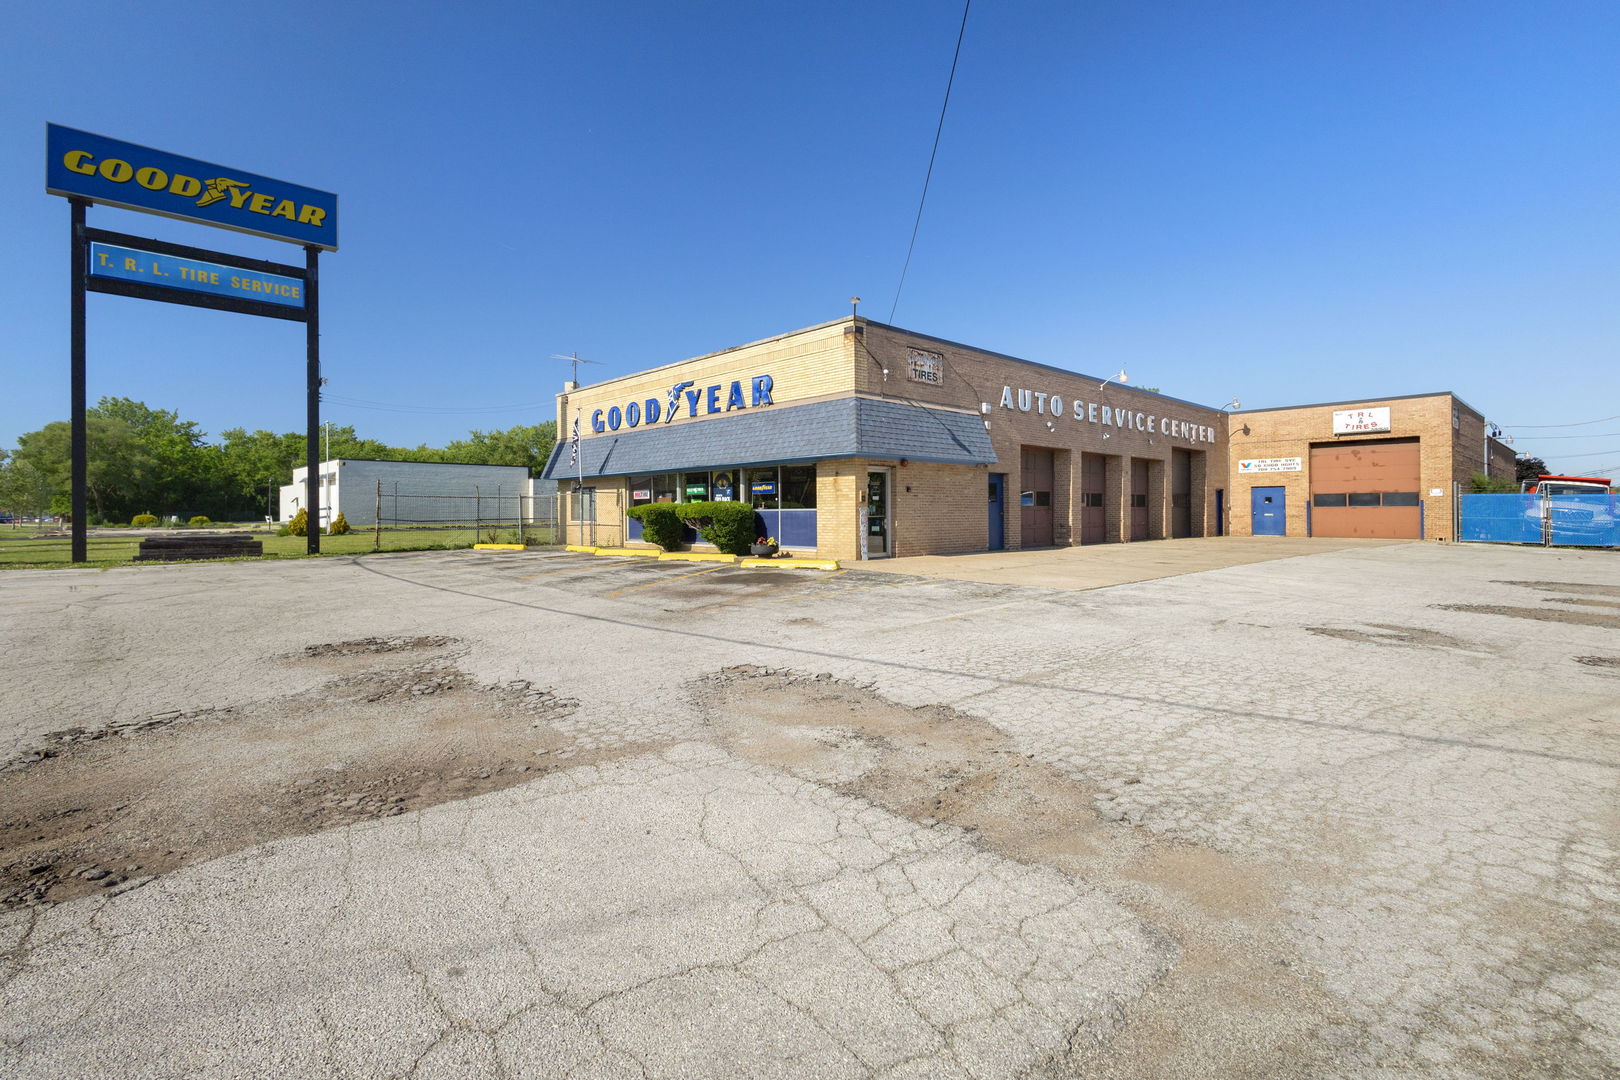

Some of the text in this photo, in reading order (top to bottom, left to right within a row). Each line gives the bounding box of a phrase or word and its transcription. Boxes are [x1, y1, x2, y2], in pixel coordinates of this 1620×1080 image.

[178, 267, 219, 285] TIRE
[231, 276, 301, 298] SERVICE
[912, 368, 938, 382] TIRES
[1000, 385, 1215, 443] AUTO SERVICE CENTER
[1345, 421, 1378, 430] TIRES
